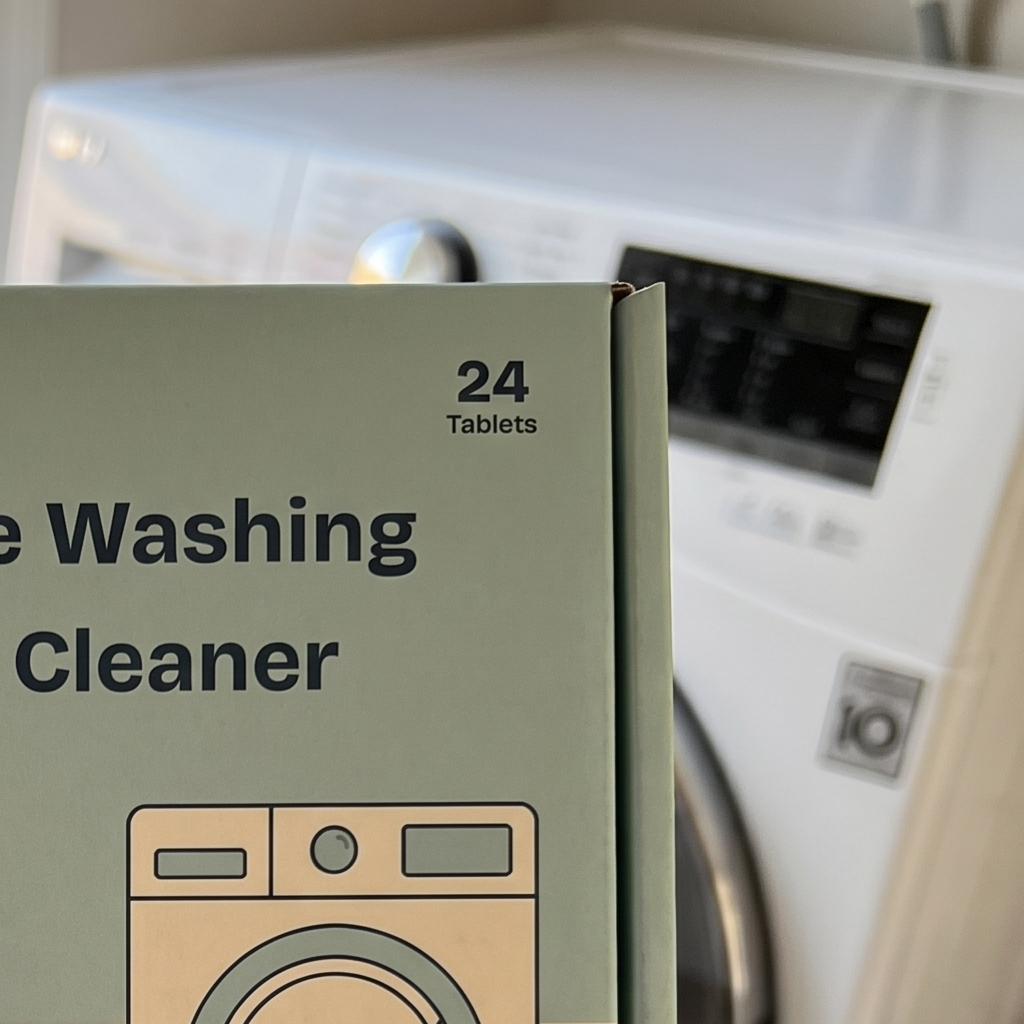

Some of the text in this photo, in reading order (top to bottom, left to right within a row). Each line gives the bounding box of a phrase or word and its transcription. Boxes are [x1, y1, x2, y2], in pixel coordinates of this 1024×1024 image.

[457, 360, 530, 403] 24
[446, 414, 538, 434] Tablets
[45, 495, 417, 577] Washing
[15, 627, 339, 693] Cleaner
